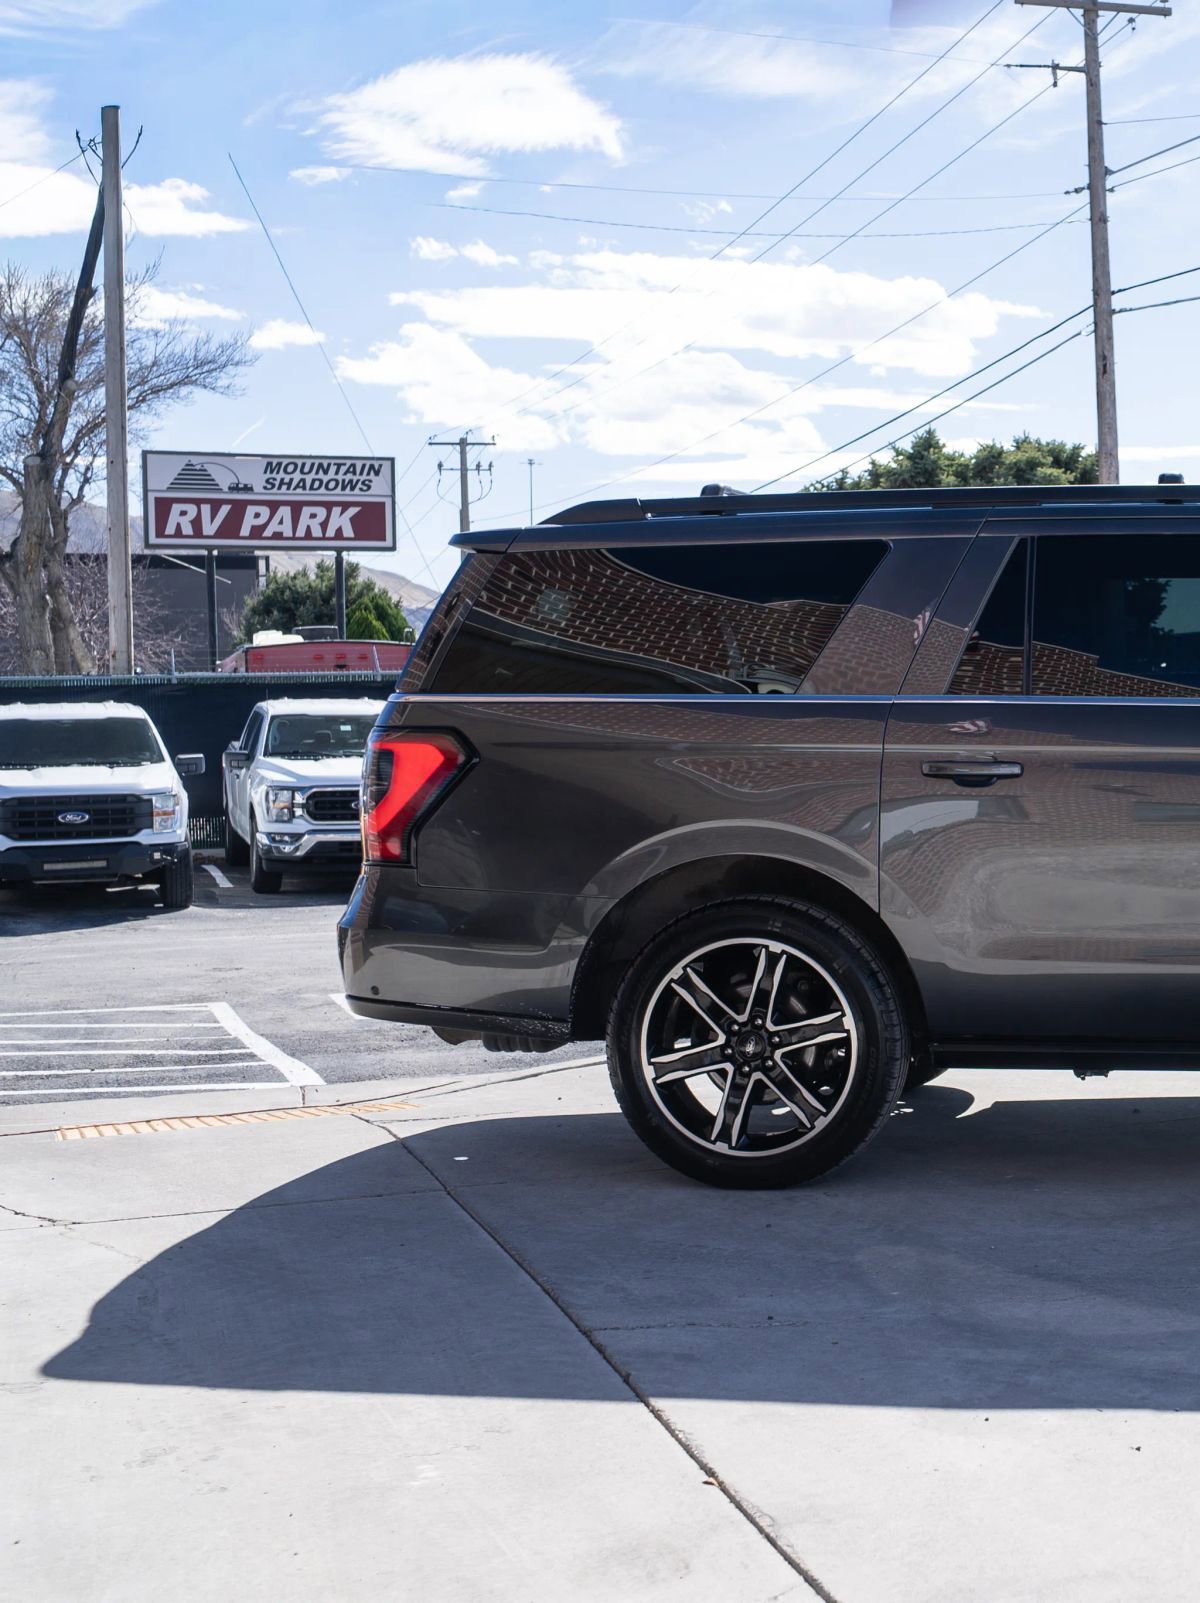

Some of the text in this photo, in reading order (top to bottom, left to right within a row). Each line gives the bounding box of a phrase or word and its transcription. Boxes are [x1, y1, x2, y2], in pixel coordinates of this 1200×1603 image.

[263, 461, 383, 477] MOUNTAIN
[262, 477, 373, 492] SHADOWS
[164, 503, 362, 538] RV PARK
